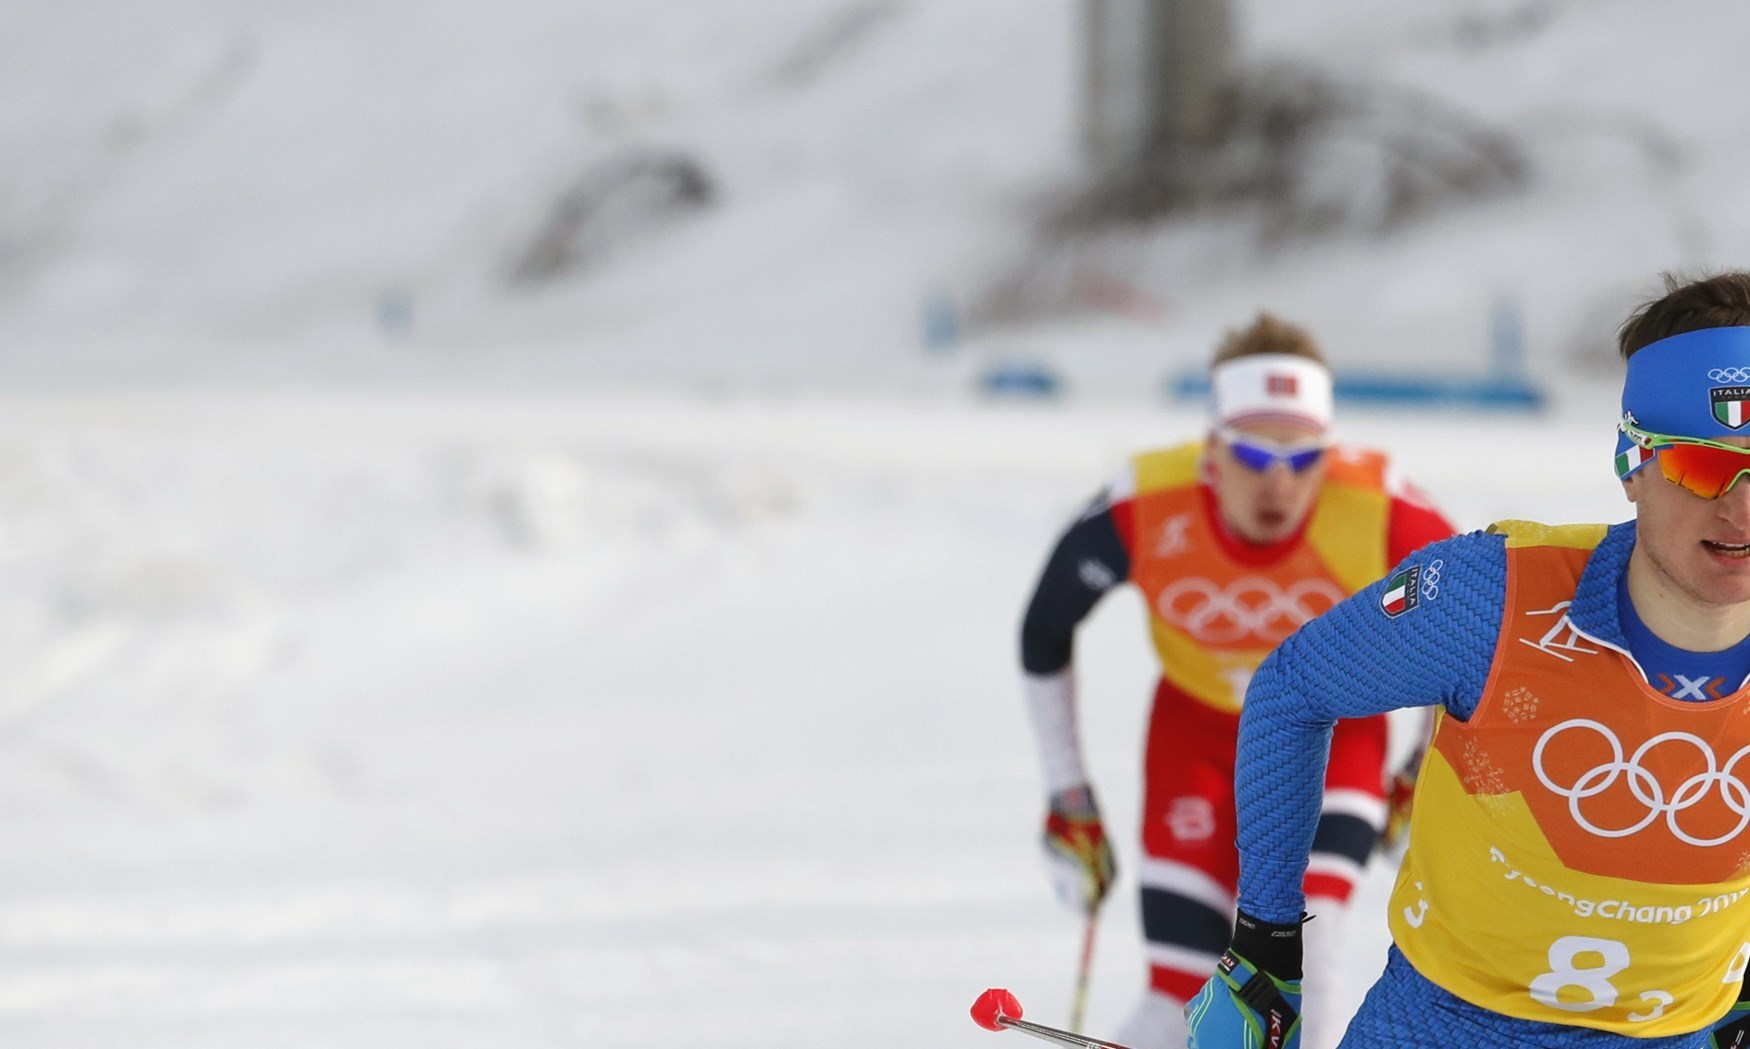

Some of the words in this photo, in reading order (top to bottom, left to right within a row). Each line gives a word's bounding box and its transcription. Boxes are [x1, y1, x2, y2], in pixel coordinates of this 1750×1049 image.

[1410, 568, 1419, 606] ITALIA
[1528, 935, 1631, 1012] 8
[1627, 990, 1674, 1022] 3
